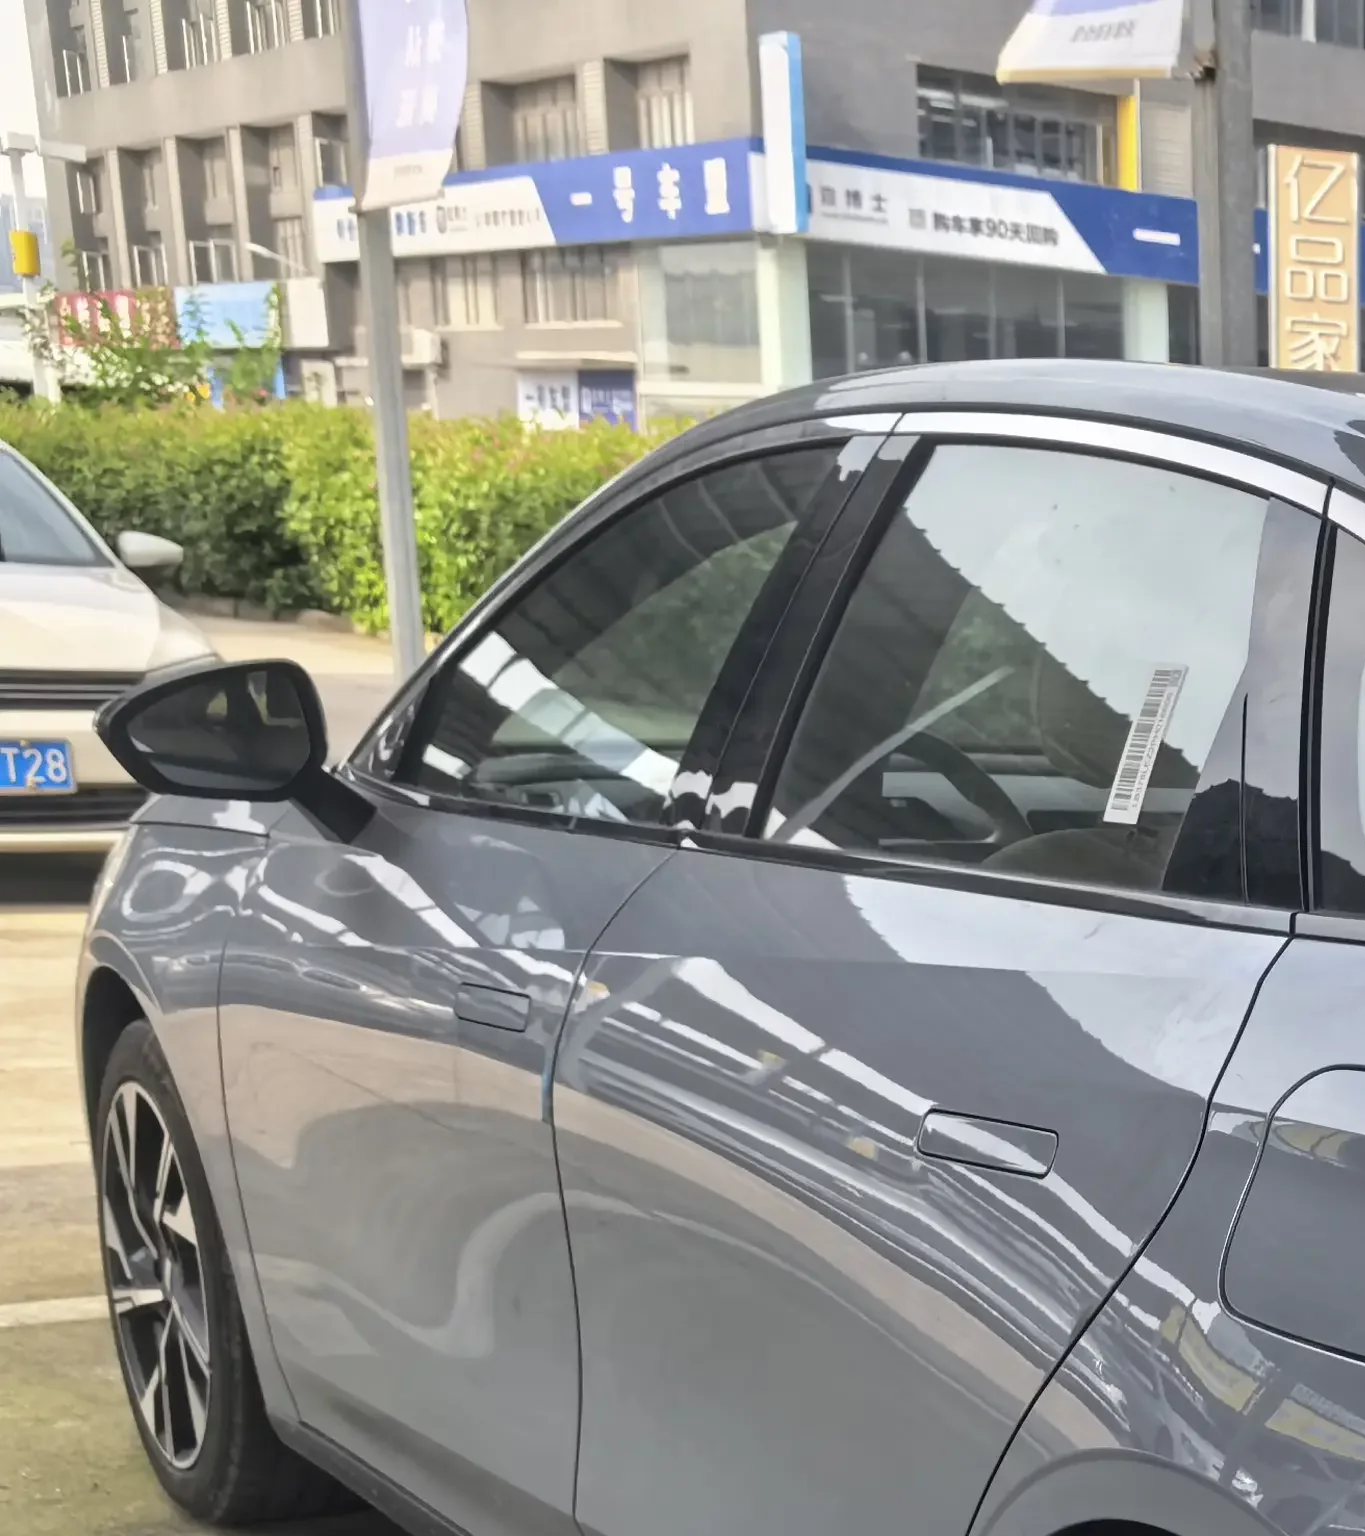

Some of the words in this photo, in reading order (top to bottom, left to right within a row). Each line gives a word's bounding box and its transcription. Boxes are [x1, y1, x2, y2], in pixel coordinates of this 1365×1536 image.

[1284, 153, 1351, 372] 亿品家
[0, 747, 67, 783] T28
